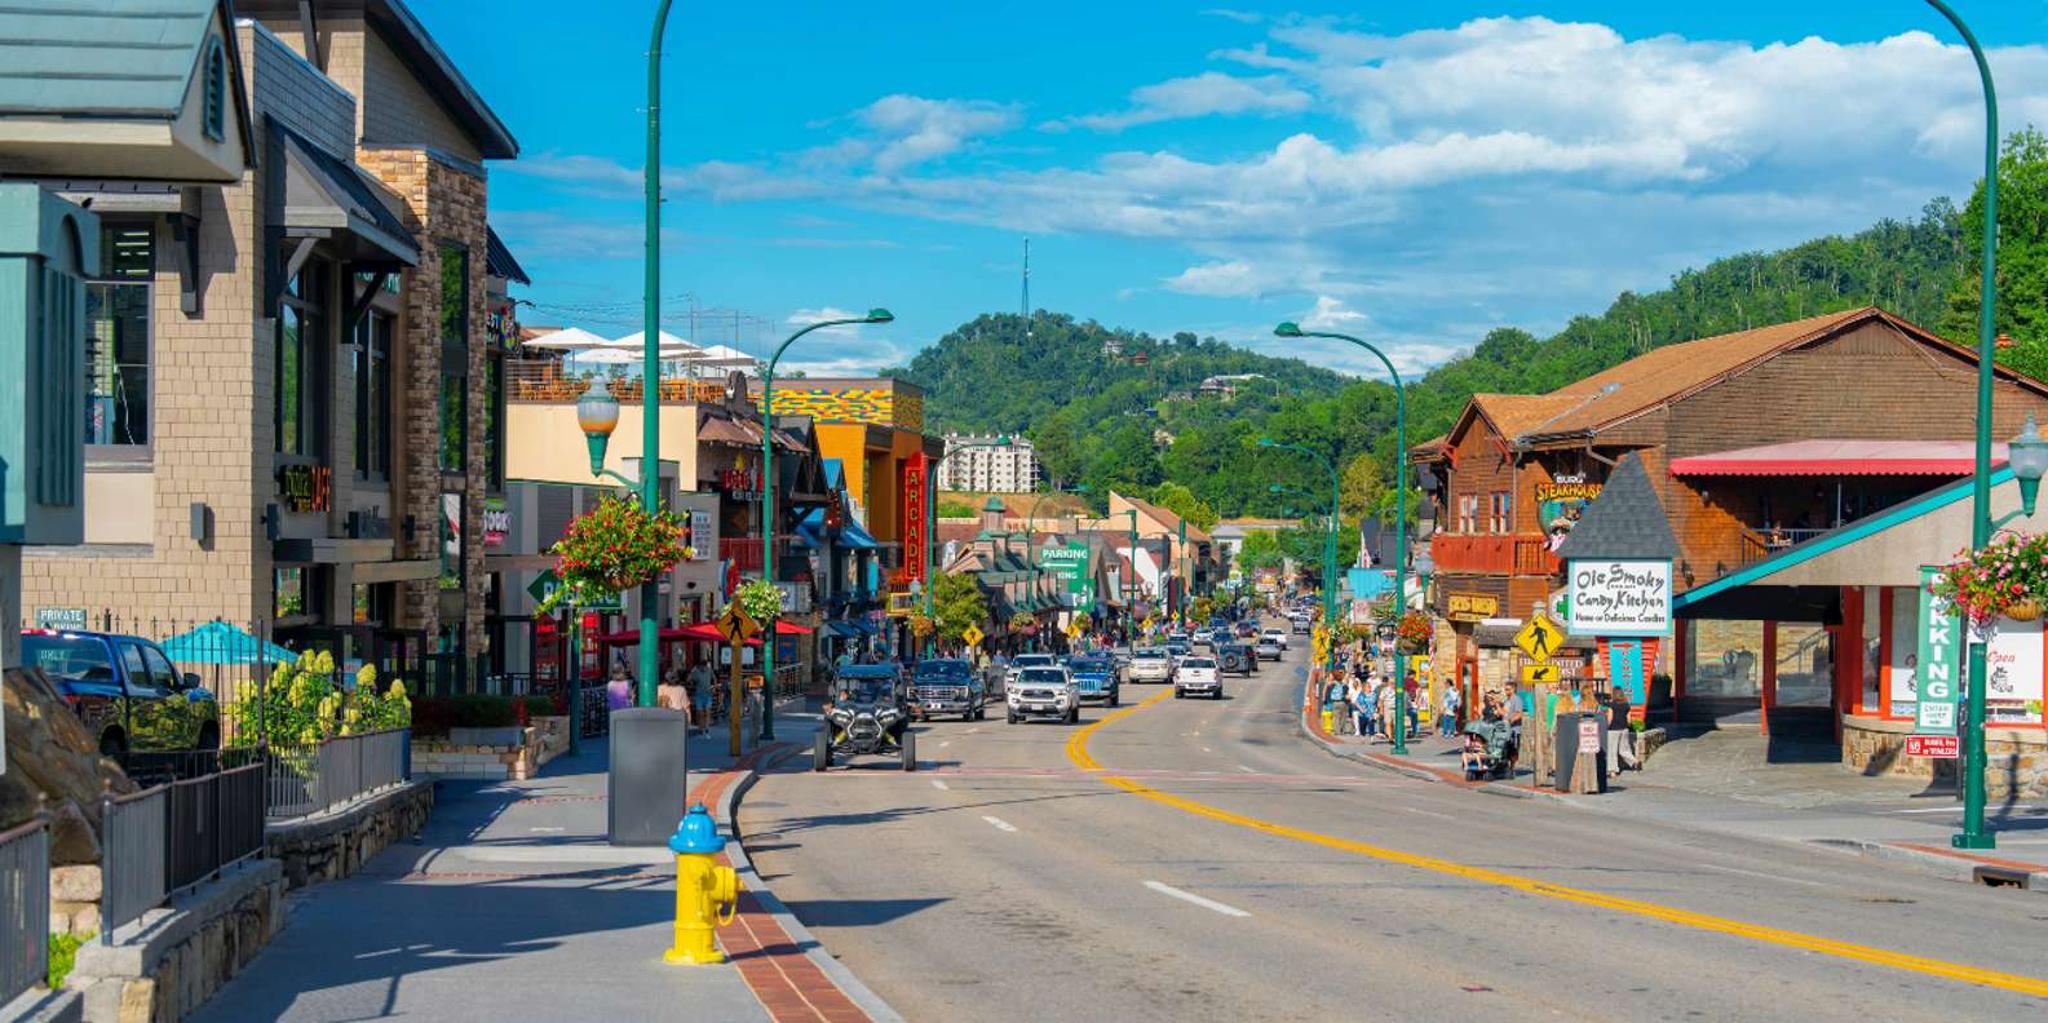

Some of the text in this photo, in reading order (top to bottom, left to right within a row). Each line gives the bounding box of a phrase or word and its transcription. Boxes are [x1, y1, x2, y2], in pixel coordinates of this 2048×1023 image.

[909, 471, 919, 575] ARCADE
[1042, 549, 1089, 559] PARKING
[1576, 563, 1665, 595] Ole Smoky
[40, 609, 81, 621] PRIVATE
[1576, 589, 1664, 616] Candy Kitchen
